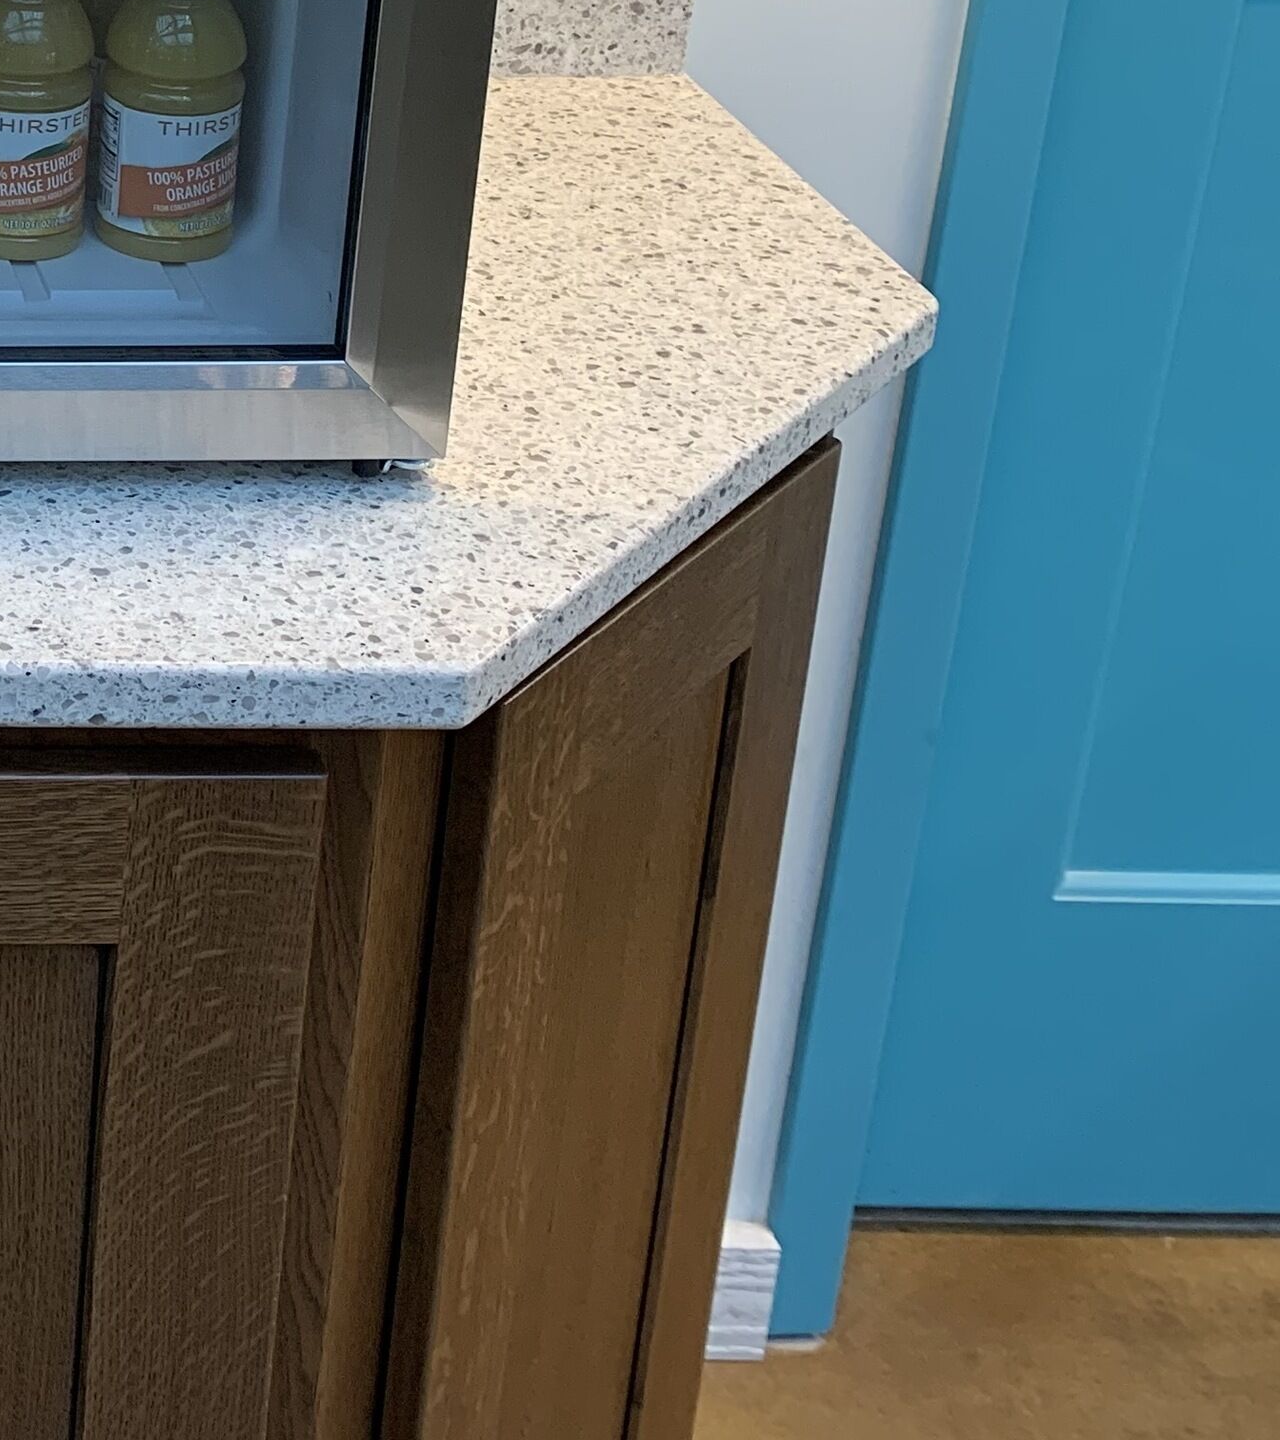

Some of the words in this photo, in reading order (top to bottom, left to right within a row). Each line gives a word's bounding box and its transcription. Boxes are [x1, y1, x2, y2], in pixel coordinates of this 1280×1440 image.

[10, 145, 83, 180] PASTEURIZED
[46, 168, 74, 192] JUICE
[147, 170, 185, 186] 100%
[166, 178, 216, 201] ORANGE
